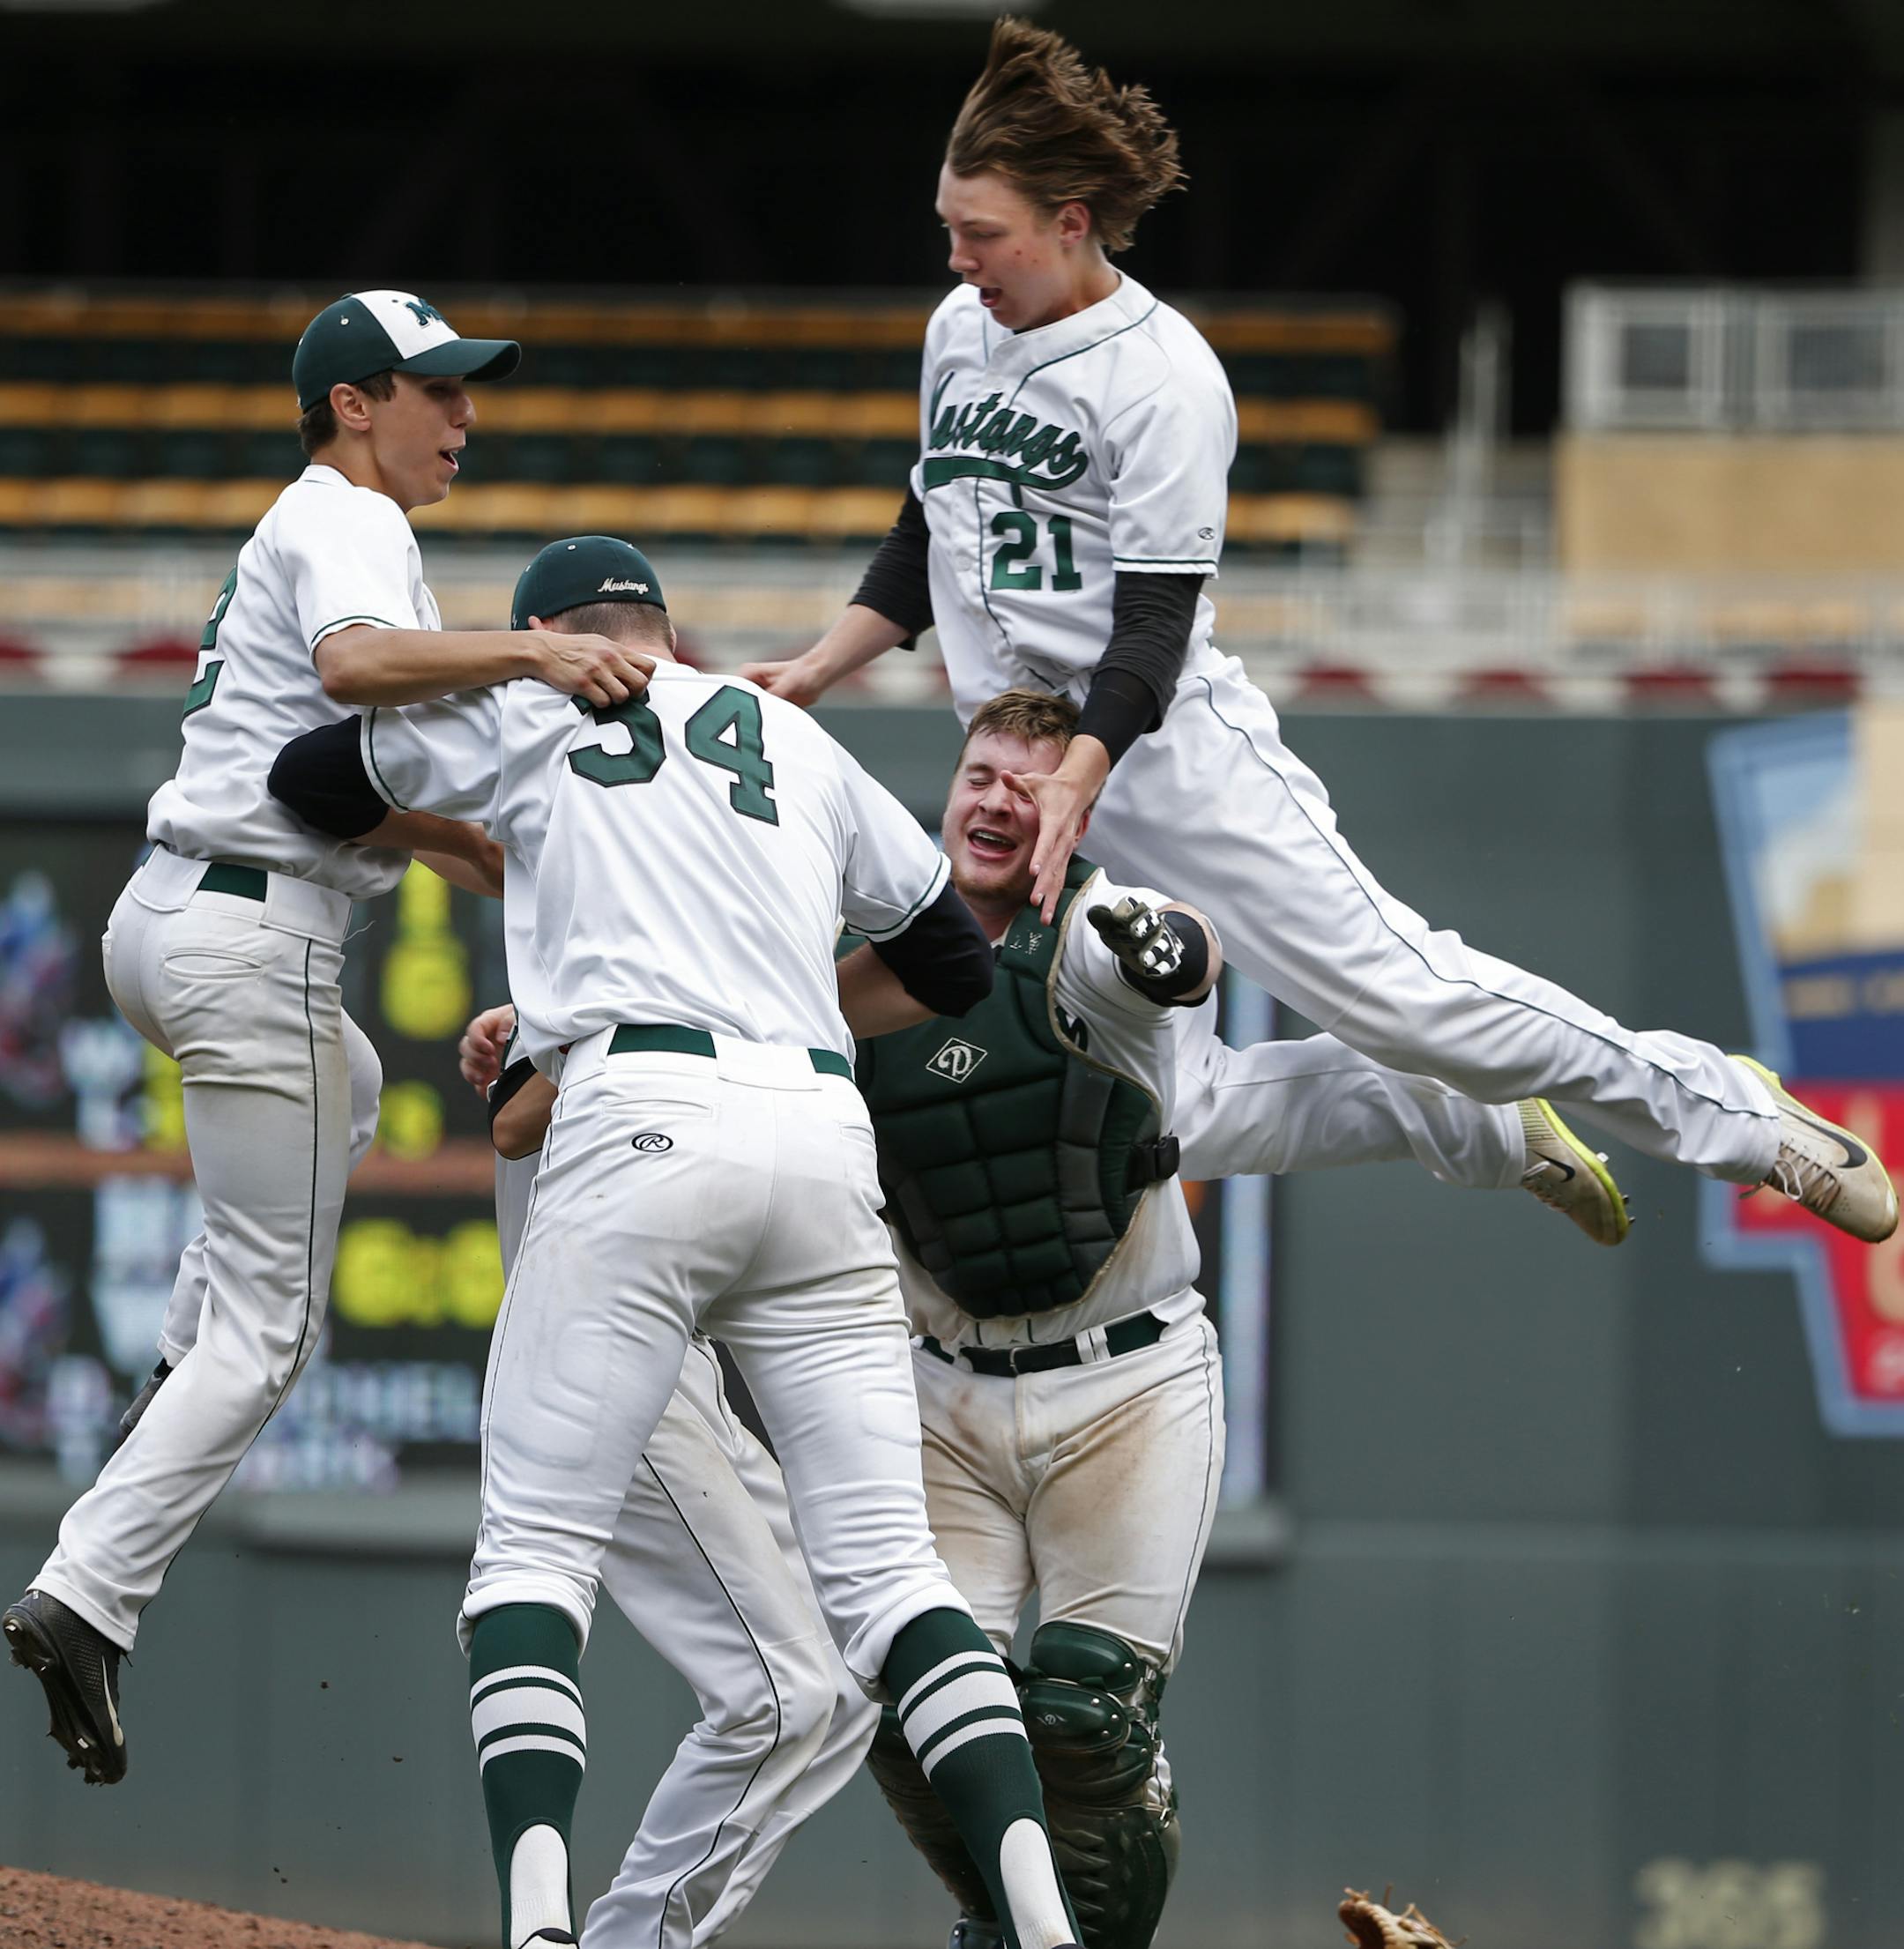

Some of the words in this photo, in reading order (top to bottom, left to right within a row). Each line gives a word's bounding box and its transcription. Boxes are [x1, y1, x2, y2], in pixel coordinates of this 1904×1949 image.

[597, 577, 649, 595] Mustangs
[990, 510, 1082, 591] 21
[568, 684, 779, 827] 34
